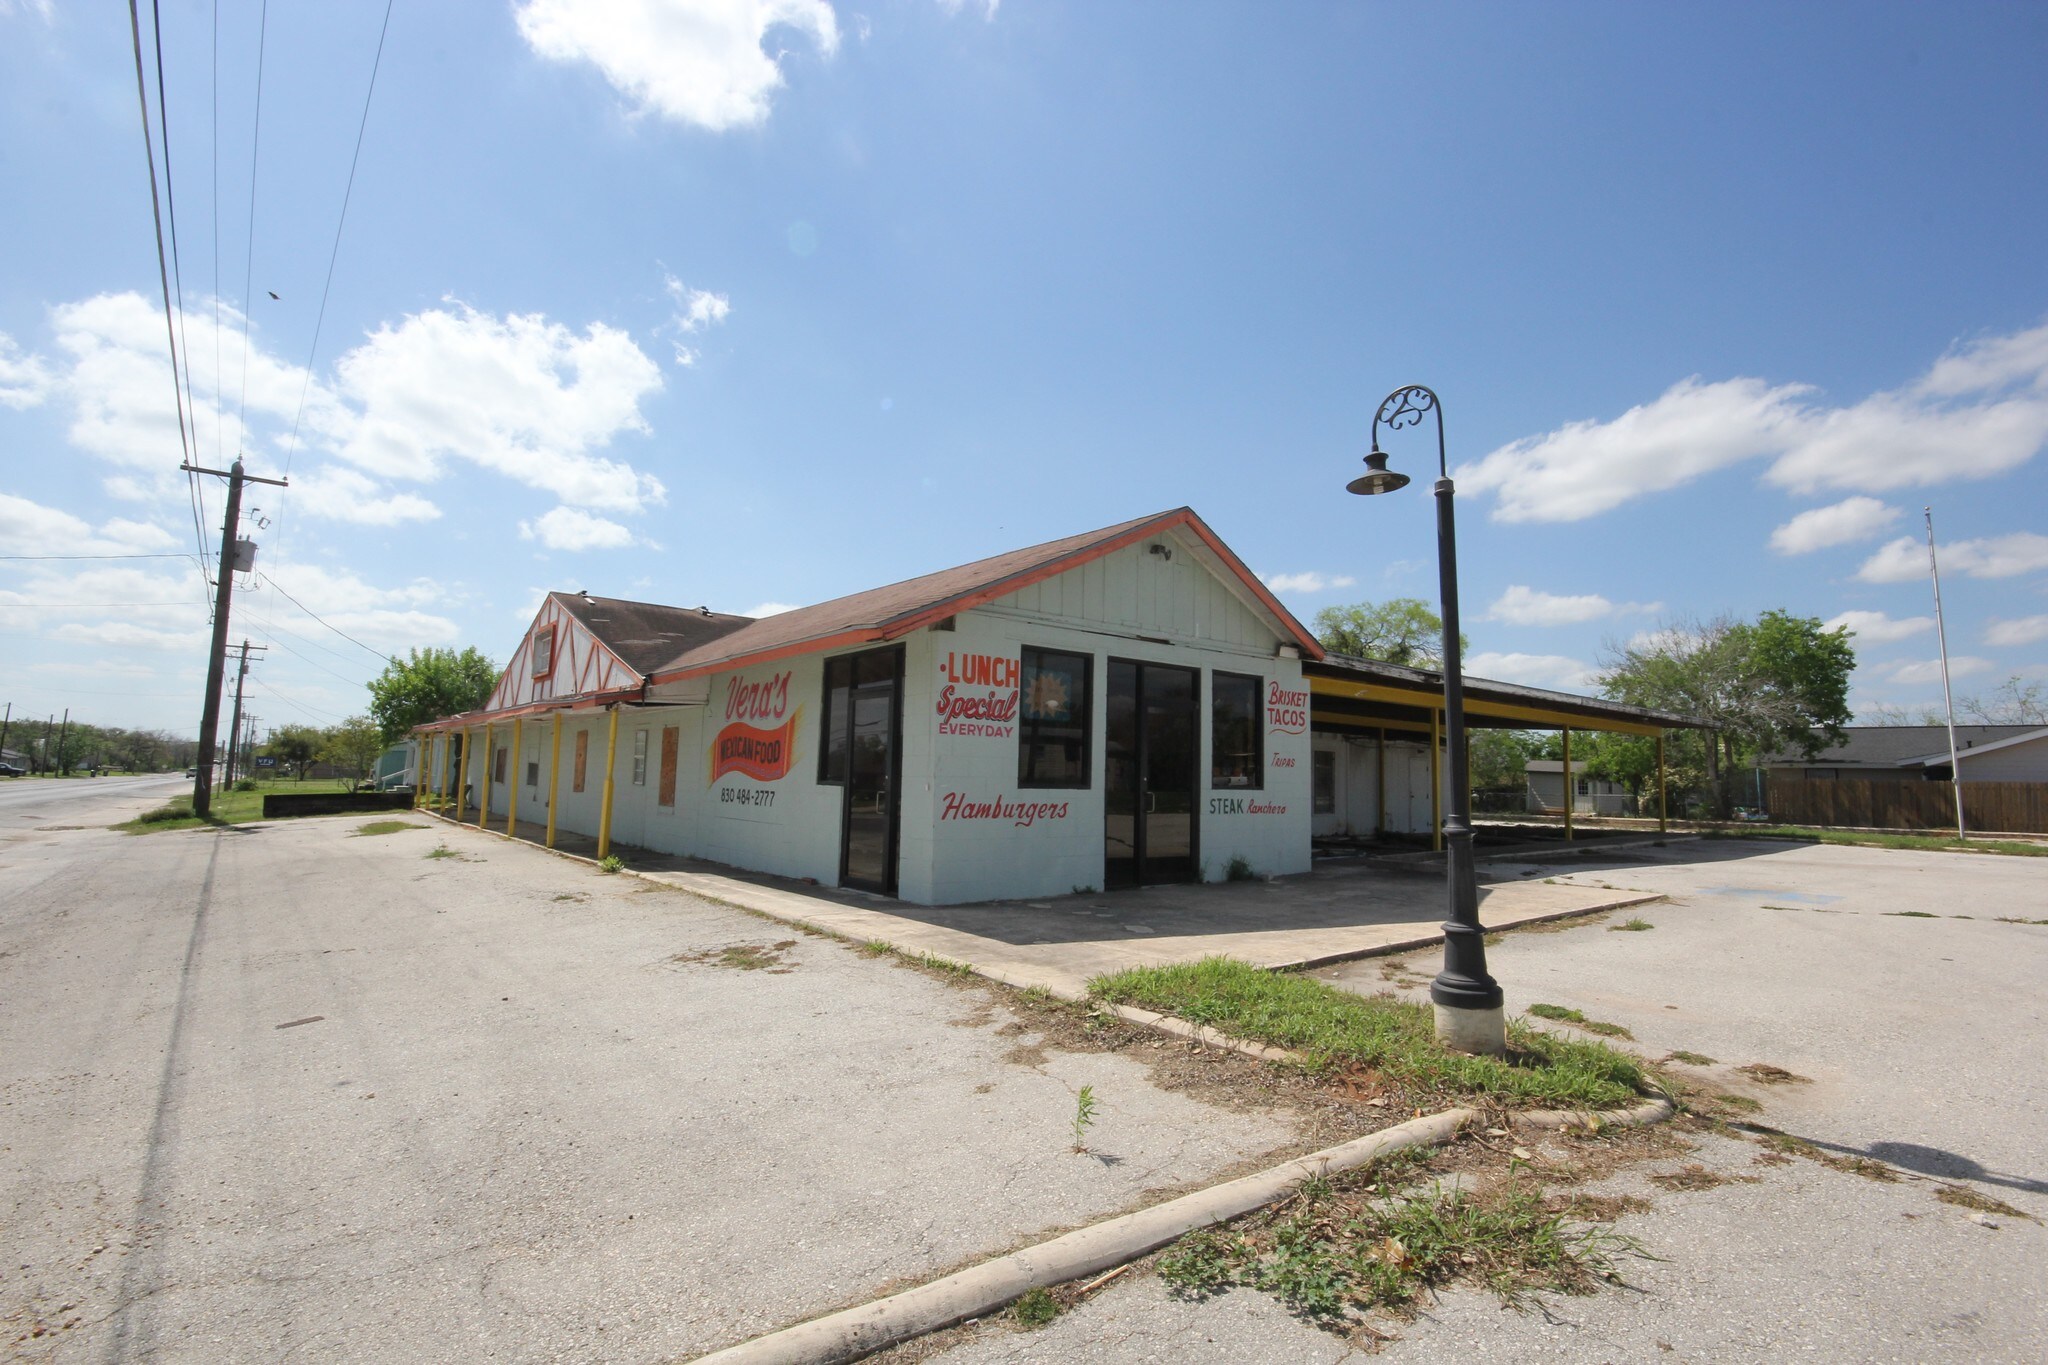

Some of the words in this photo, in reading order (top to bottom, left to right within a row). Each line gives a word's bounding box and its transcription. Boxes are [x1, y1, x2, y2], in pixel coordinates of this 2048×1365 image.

[725, 670, 792, 720] Vera's
[936, 685, 1019, 724] Special
[1267, 708, 1306, 727] TACOS
[939, 723, 1014, 738] EVERYDAY
[721, 736, 754, 761] MEXICAN
[754, 740, 780, 764] FOOD
[721, 788, 735, 803] 830
[736, 789, 776, 807] 484-2777
[1209, 798, 1244, 815] STEAK
[1246, 799, 1287, 815] Ranchero
[941, 792, 1069, 827] Hamburgers
